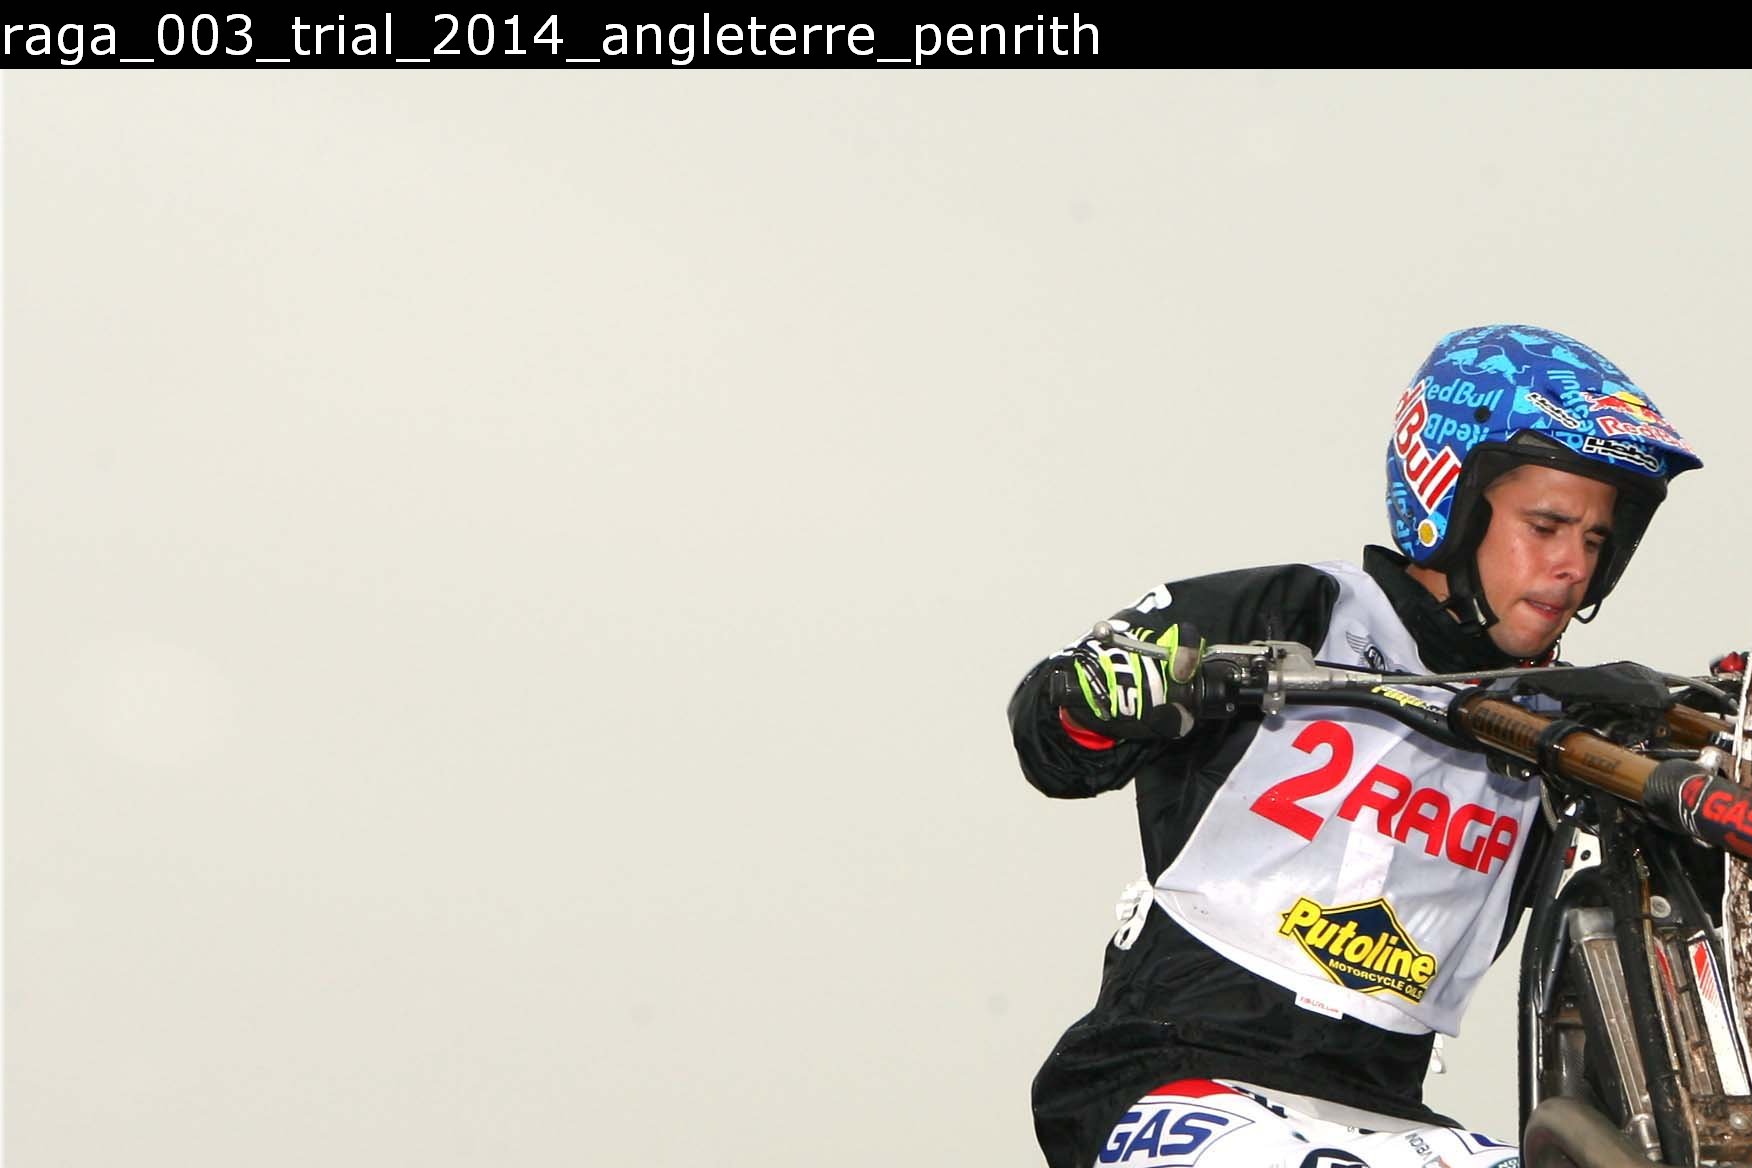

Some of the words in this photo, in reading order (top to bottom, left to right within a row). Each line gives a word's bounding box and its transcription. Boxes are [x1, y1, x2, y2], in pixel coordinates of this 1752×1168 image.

[1249, 719, 1354, 842] 2
[1336, 763, 1519, 875] RAGA
[1279, 897, 1437, 985] Putoline
[1328, 958, 1405, 991] MOTORCYCLE
[1099, 1108, 1230, 1164] GAS
